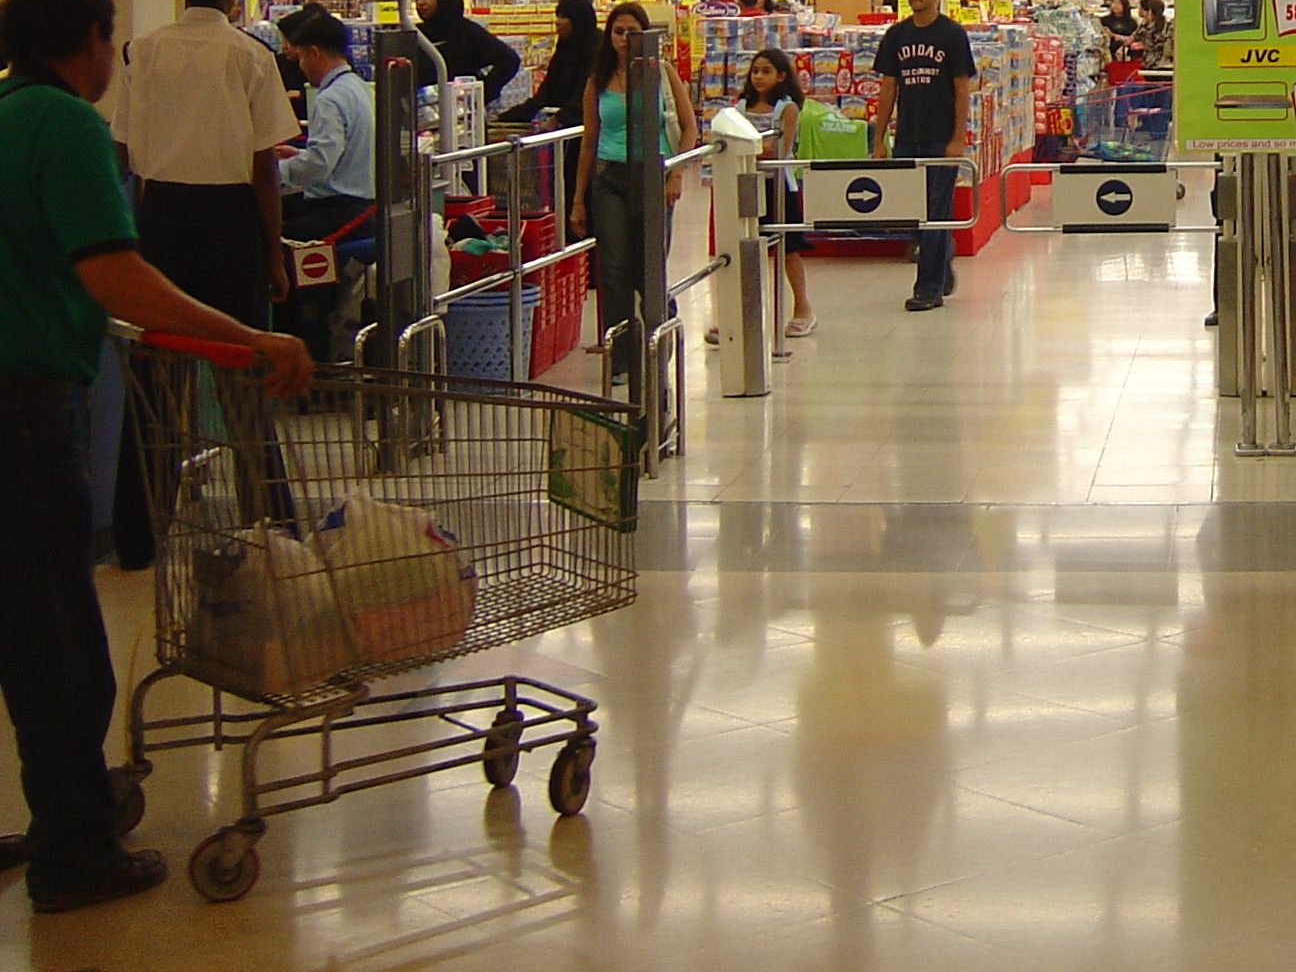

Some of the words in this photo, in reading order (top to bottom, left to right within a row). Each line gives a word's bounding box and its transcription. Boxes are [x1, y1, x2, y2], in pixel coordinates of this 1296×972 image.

[1241, 49, 1280, 63] JVC
[1193, 139, 1215, 148] Low
[1218, 139, 1249, 149] prices
[1252, 139, 1270, 147] and
